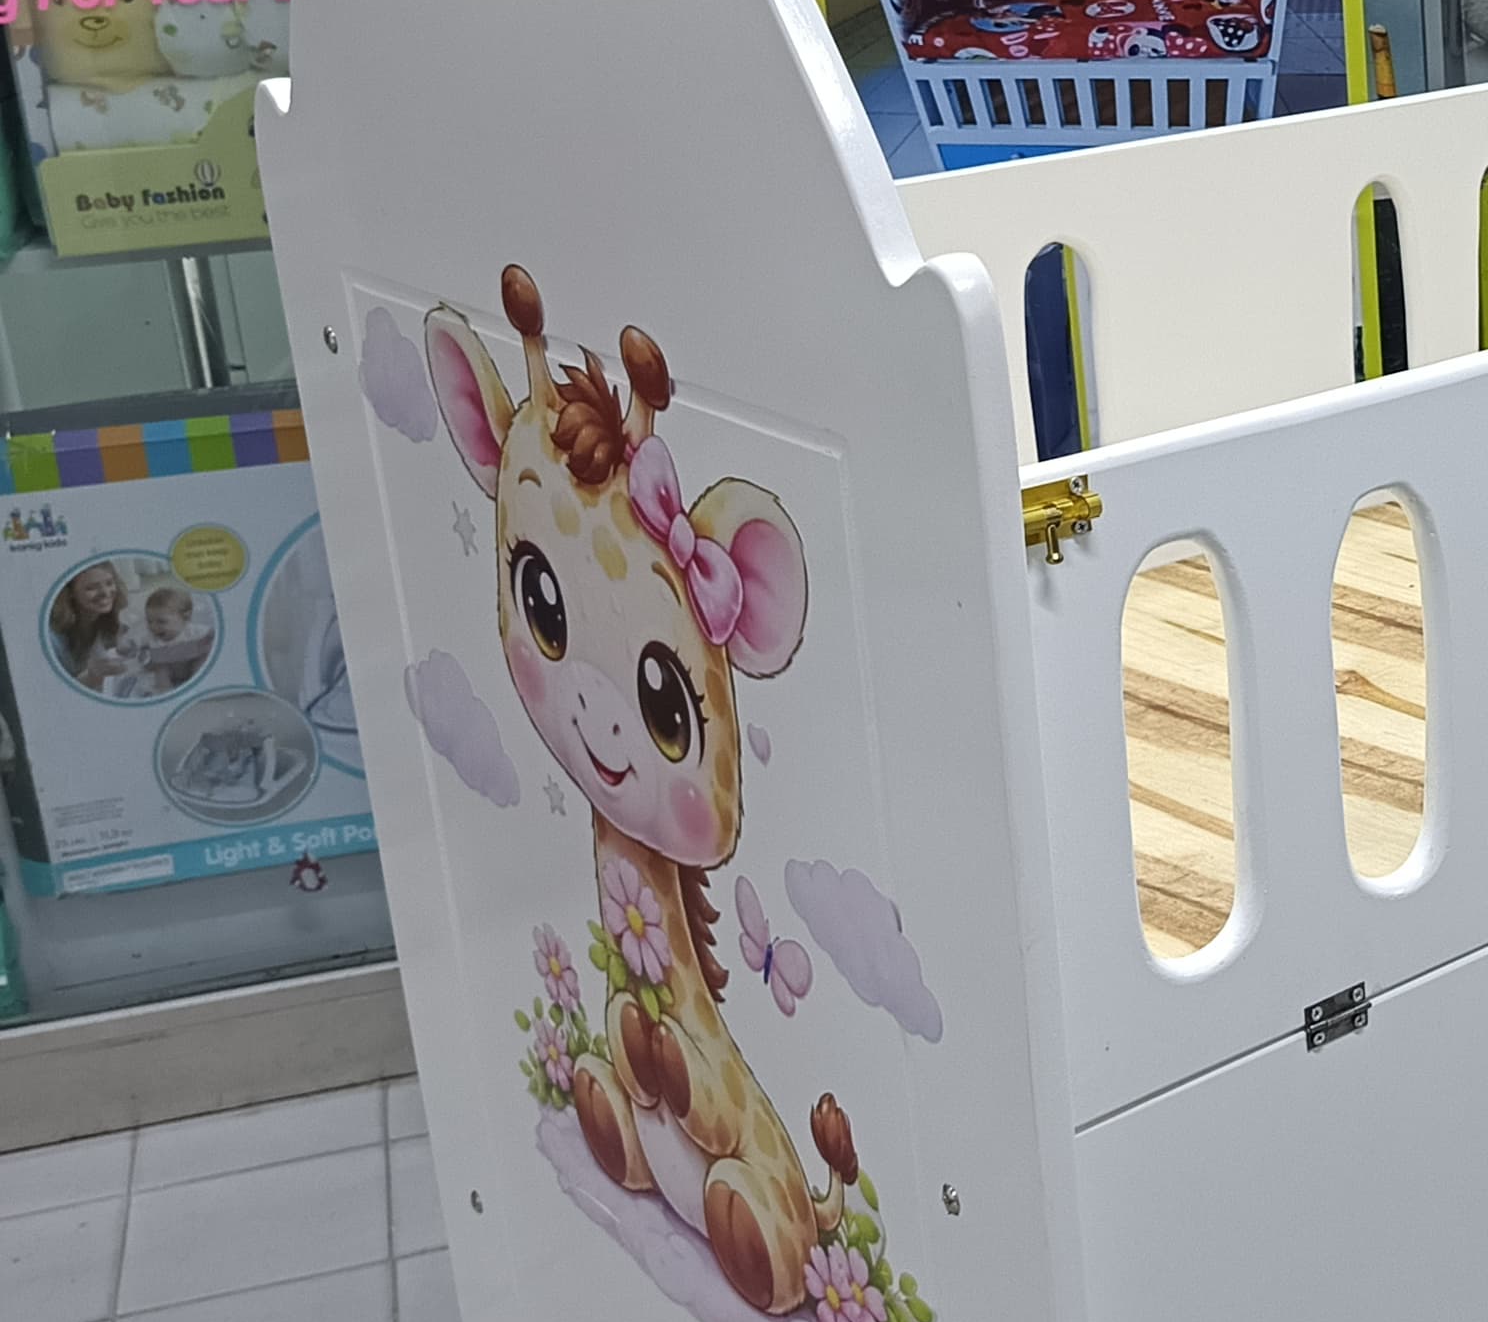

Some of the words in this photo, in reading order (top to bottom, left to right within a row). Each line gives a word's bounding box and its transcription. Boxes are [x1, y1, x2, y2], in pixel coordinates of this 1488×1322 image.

[76, 192, 134, 212] Baby
[205, 839, 262, 867] Light
[267, 836, 287, 855] &
[292, 827, 337, 853] Soft
[343, 824, 379, 843] Po
